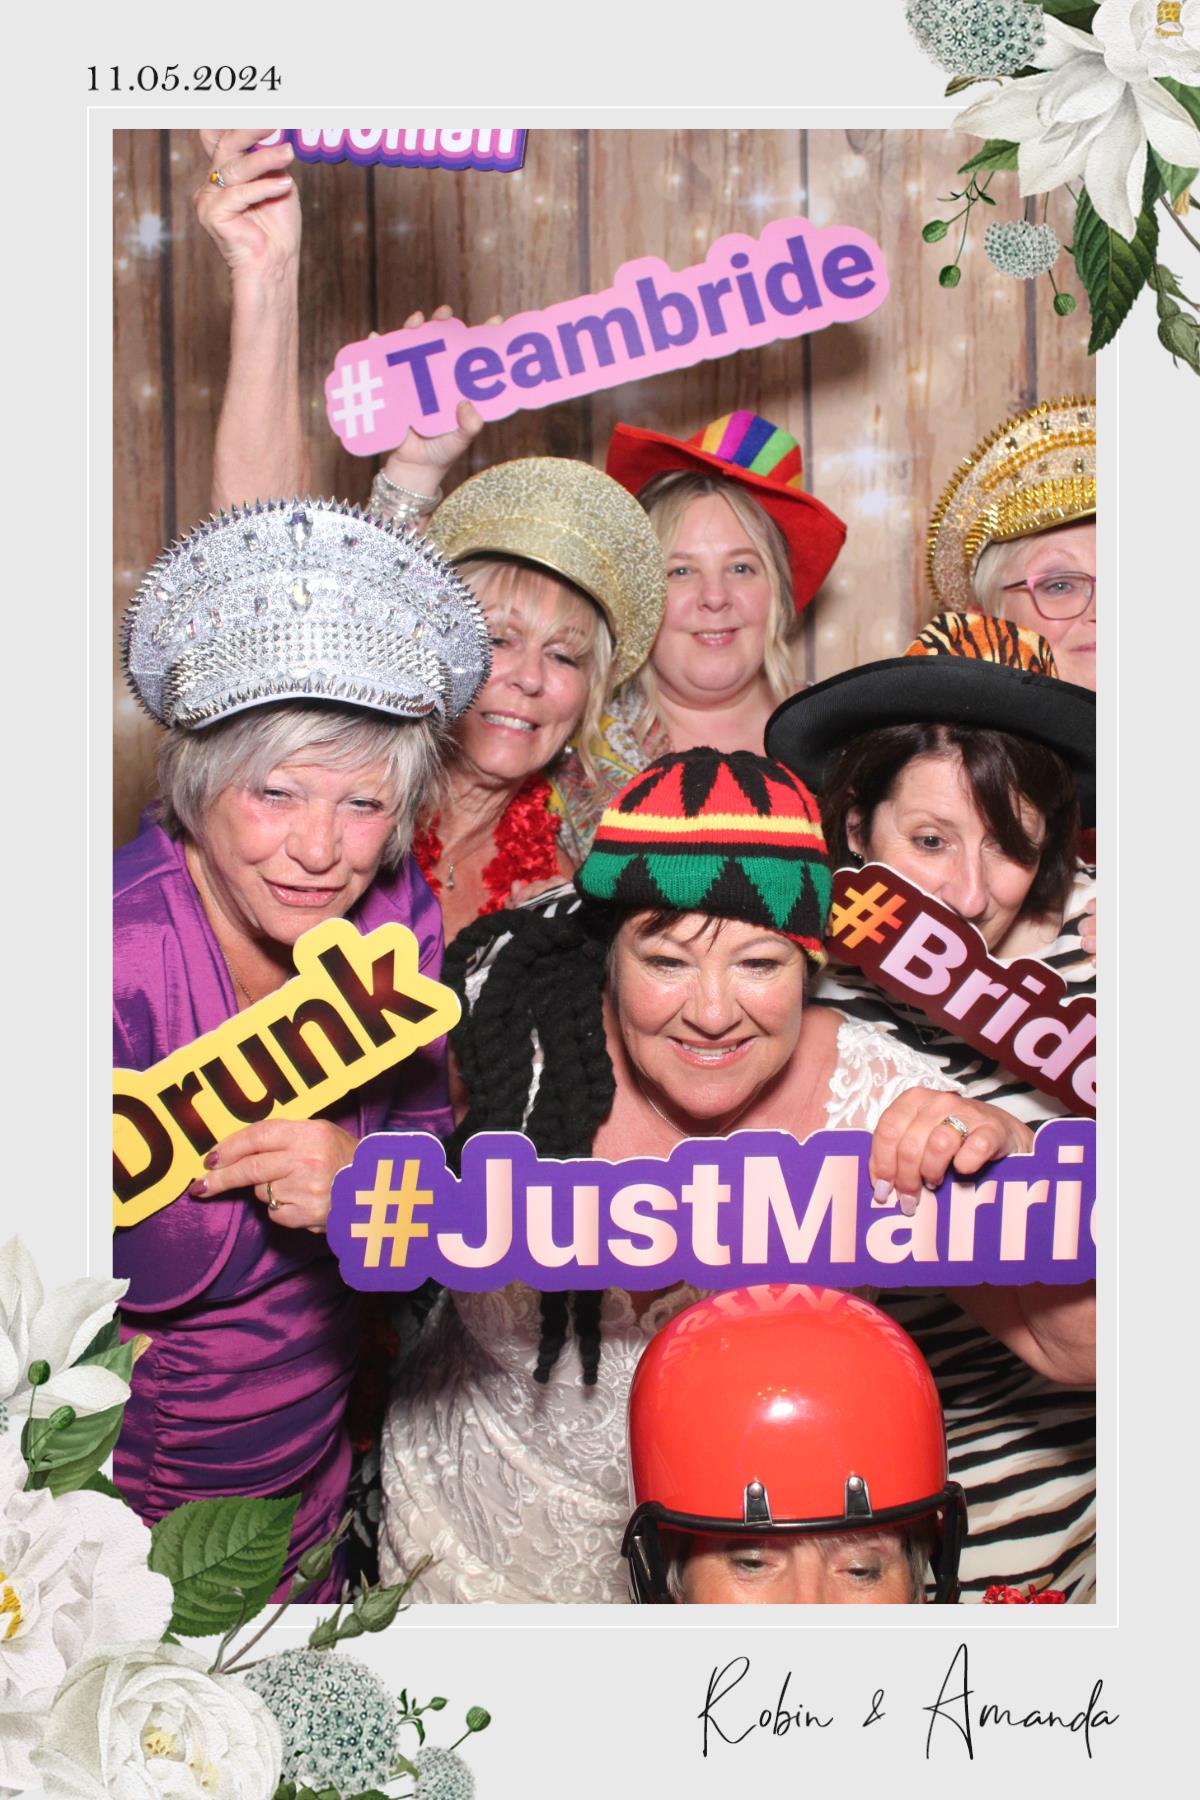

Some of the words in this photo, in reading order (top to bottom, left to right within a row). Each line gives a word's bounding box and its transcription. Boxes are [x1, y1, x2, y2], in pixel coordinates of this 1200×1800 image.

[331, 234, 876, 439] #Teambride
[113, 944, 438, 1204] Drunk
[350, 1144, 1096, 1269] #JustMarri
